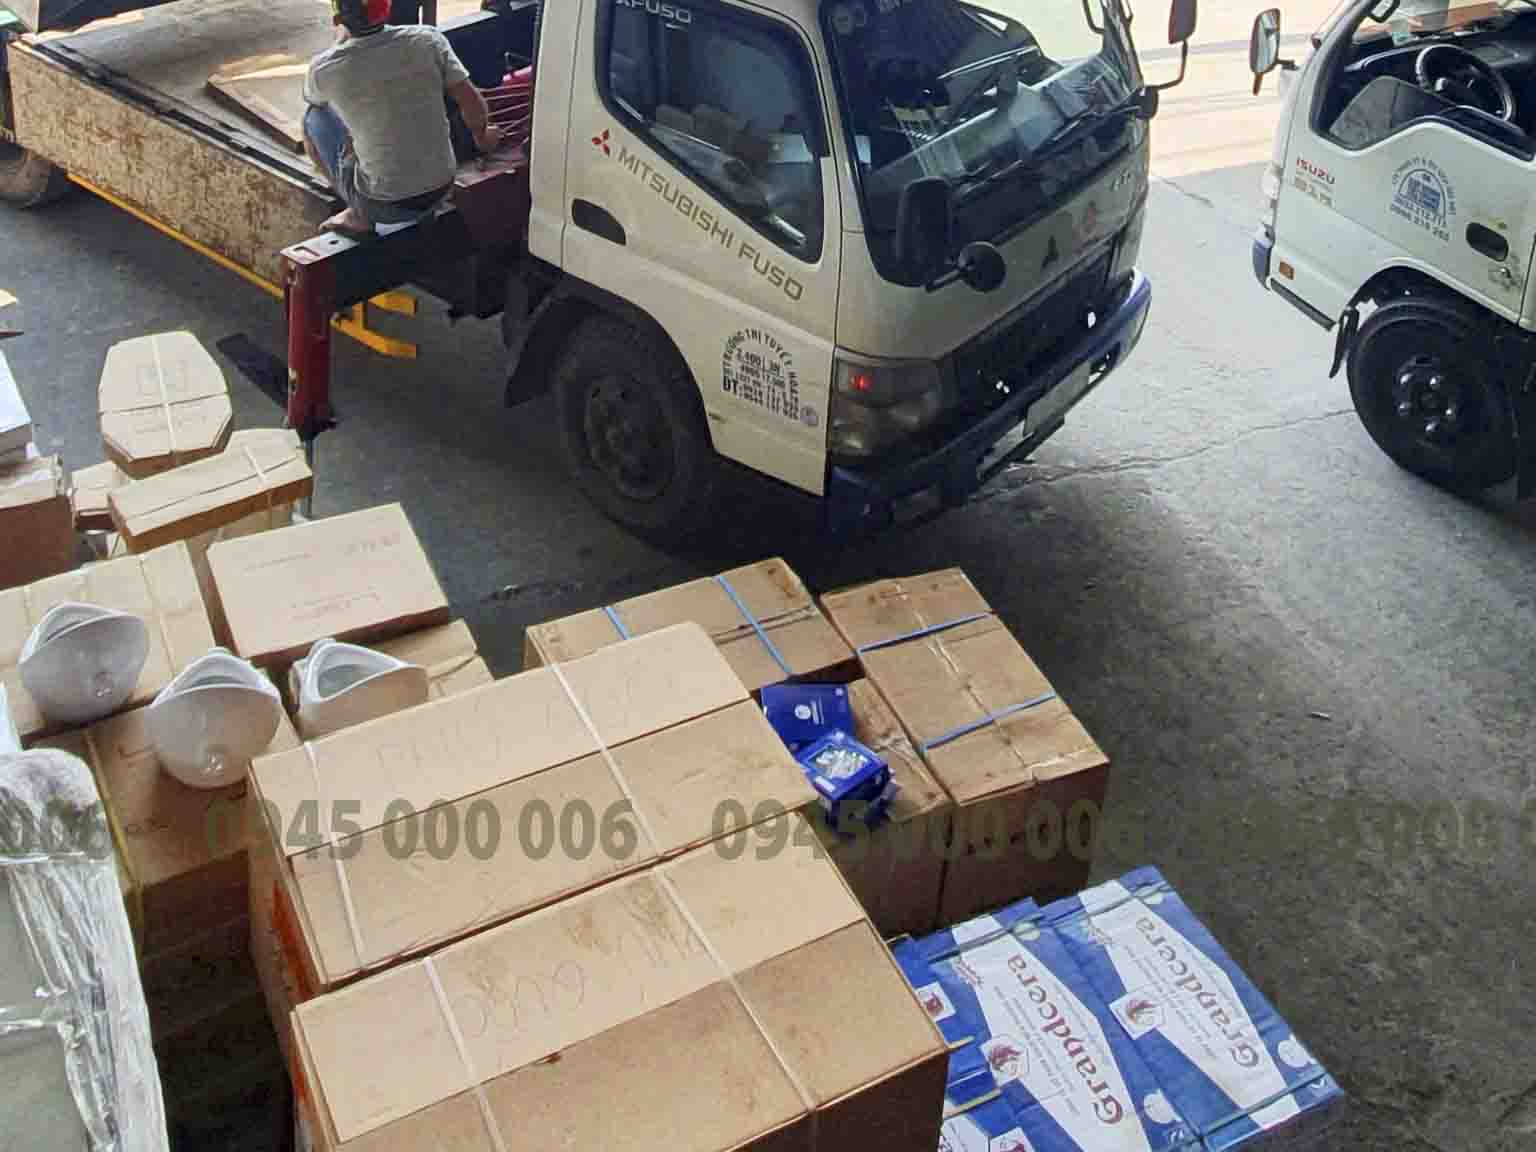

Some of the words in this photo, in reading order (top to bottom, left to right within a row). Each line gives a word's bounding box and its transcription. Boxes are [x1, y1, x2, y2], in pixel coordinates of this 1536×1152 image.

[617, 146, 735, 250] MITSUBISHI
[737, 243, 805, 302] FUSO
[1296, 157, 1336, 185] ISUZU
[1006, 952, 1125, 1127] Grandcera
[1134, 915, 1260, 1070] Grandcera
